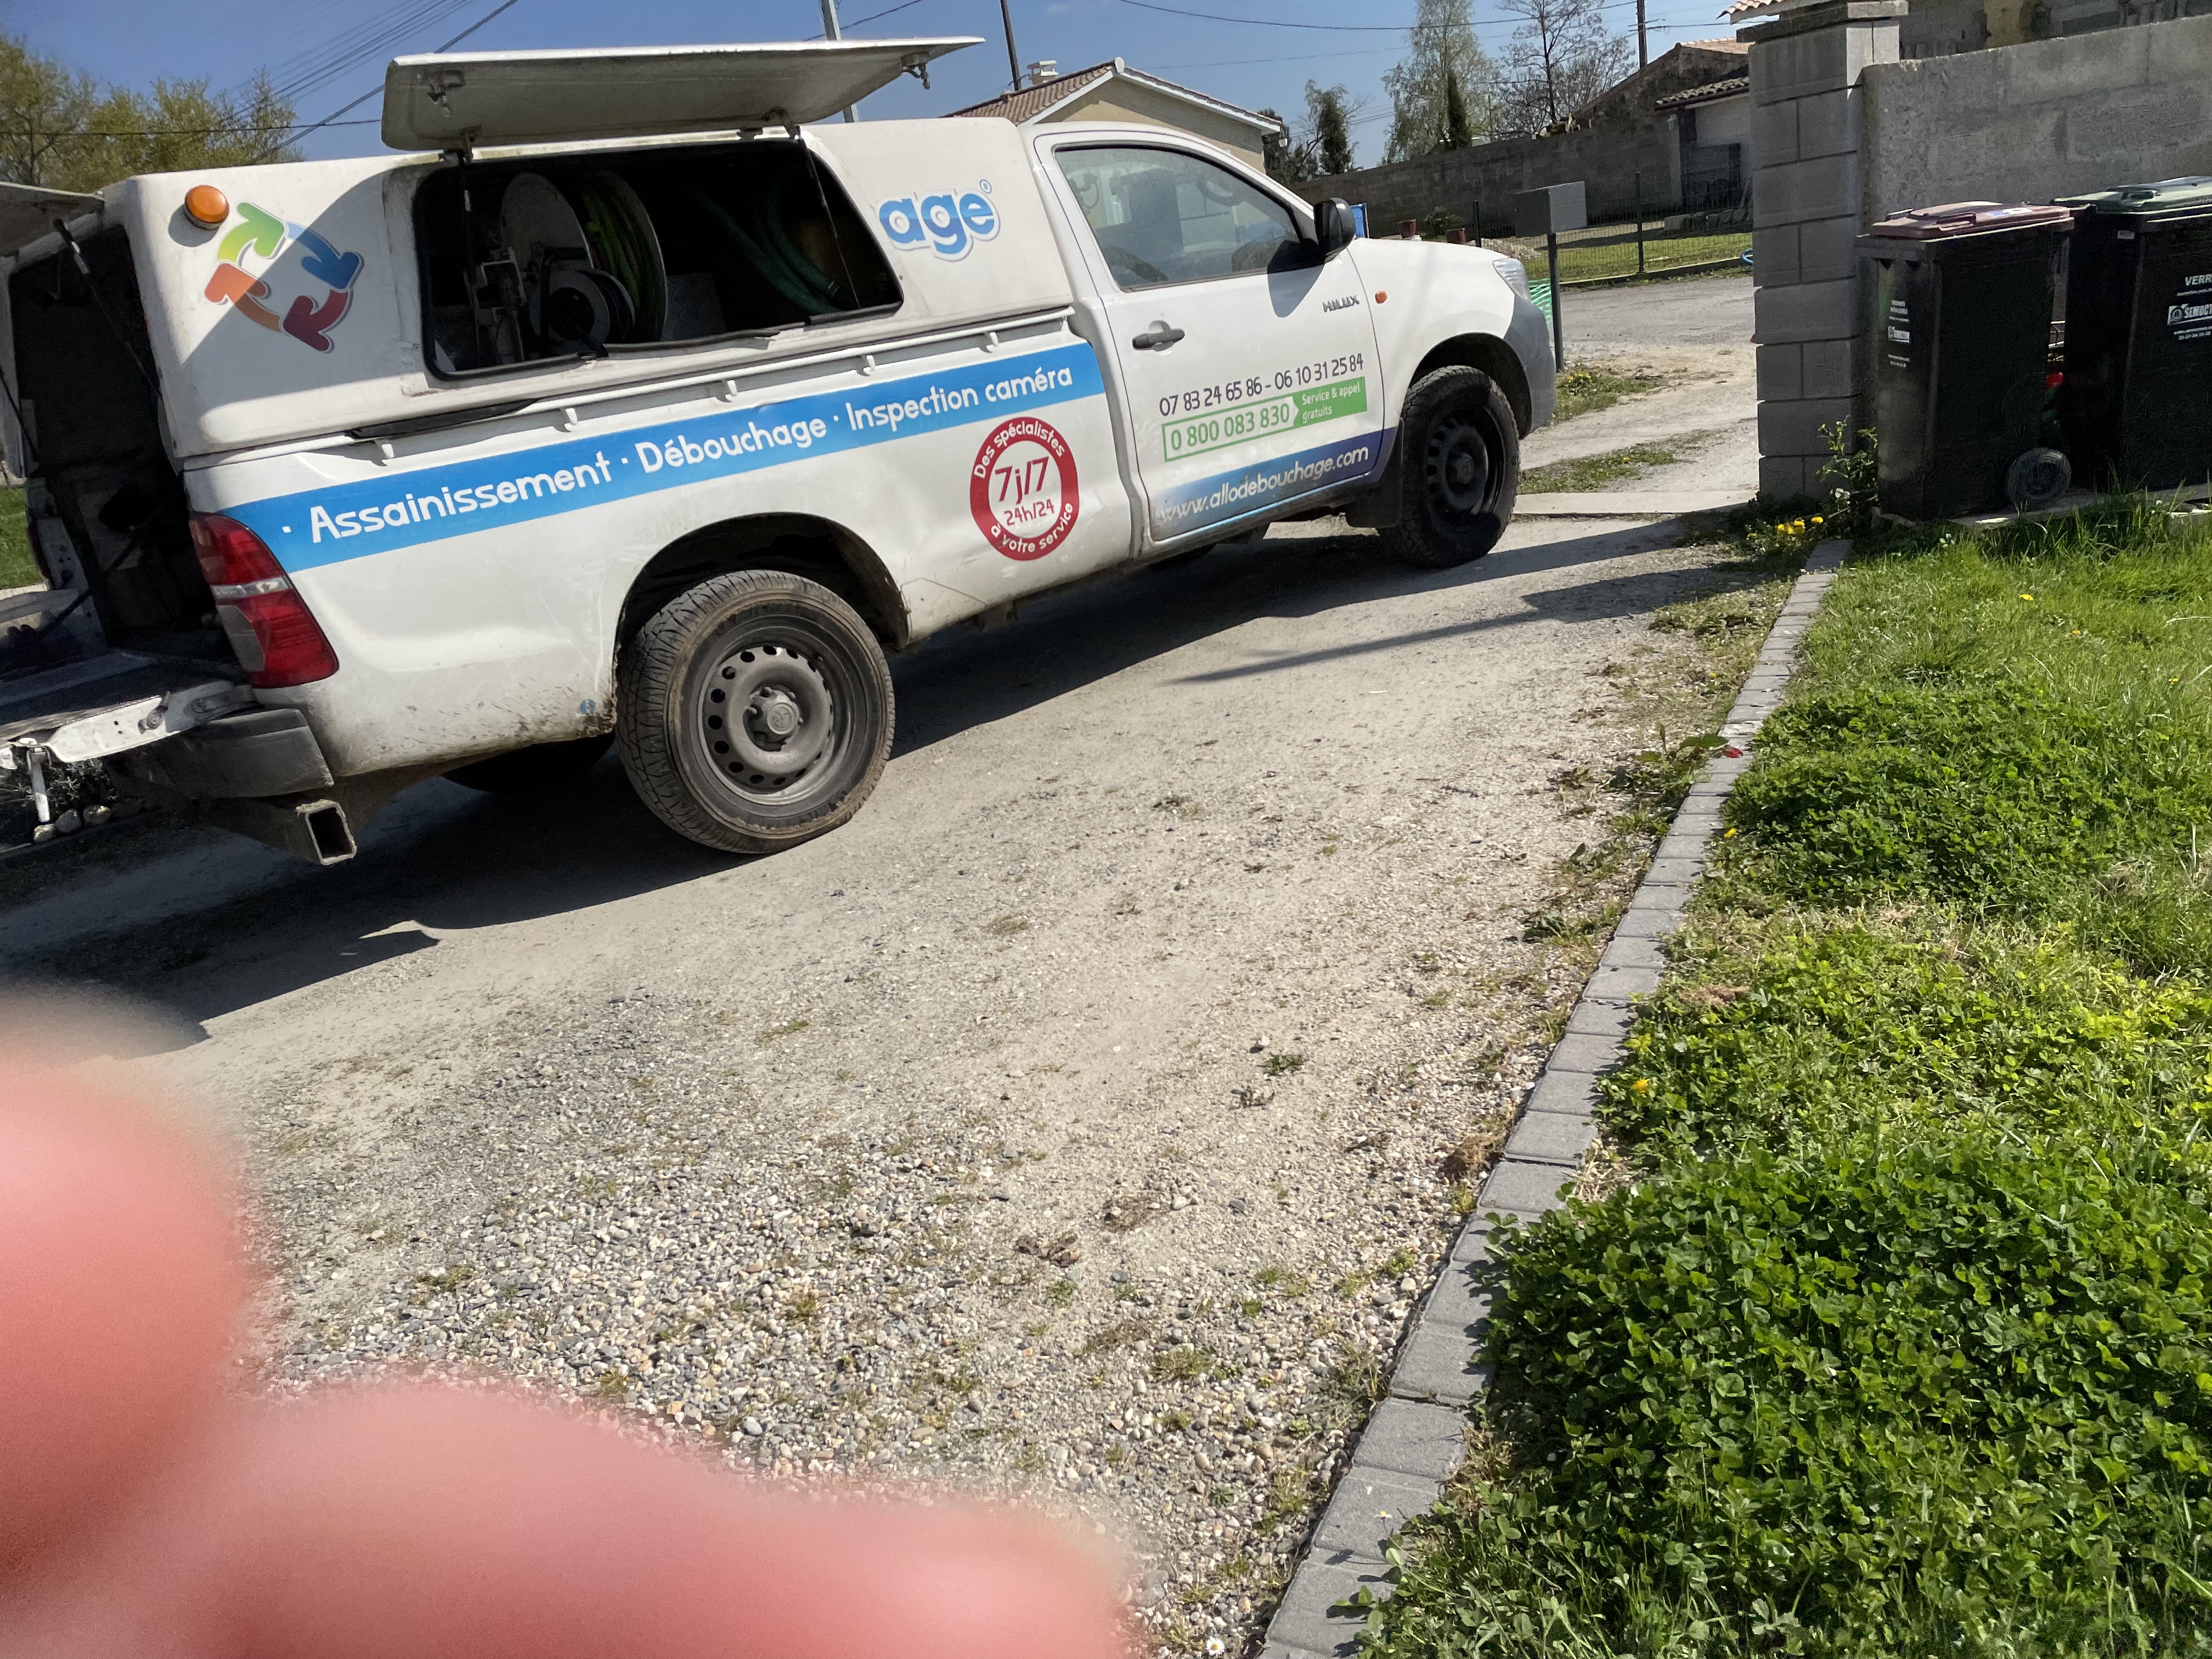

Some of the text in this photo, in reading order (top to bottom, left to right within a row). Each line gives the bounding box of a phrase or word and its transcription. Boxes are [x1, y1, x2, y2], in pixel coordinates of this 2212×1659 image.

[1323, 295, 1359, 313] HILUX
[1159, 395, 1178, 416] 07
[1184, 391, 1200, 411] 83
[1204, 386, 1222, 407] 24
[1226, 381, 1243, 400] 65
[1246, 376, 1262, 397] 86
[1274, 370, 1293, 390] 06
[1296, 366, 1311, 385] 10
[1314, 361, 1328, 381] 31
[1331, 357, 1347, 377] 25
[1349, 353, 1364, 372] 84
[1302, 382, 1361, 405] Service & appel
[1171, 403, 1290, 451] 0 800 083 830
[1302, 405, 1332, 424] gratuits
[310, 366, 1073, 543] Assainissement Débouchage Inspection caméra
[974, 421, 1065, 479] Des spécialistes
[995, 456, 1049, 505] 7j/7
[1159, 445, 1368, 524] www.allodebouchage.com
[1002, 534, 1036, 553] votre
[1039, 503, 1073, 550] service
[1004, 499, 1054, 527] 24h/24
